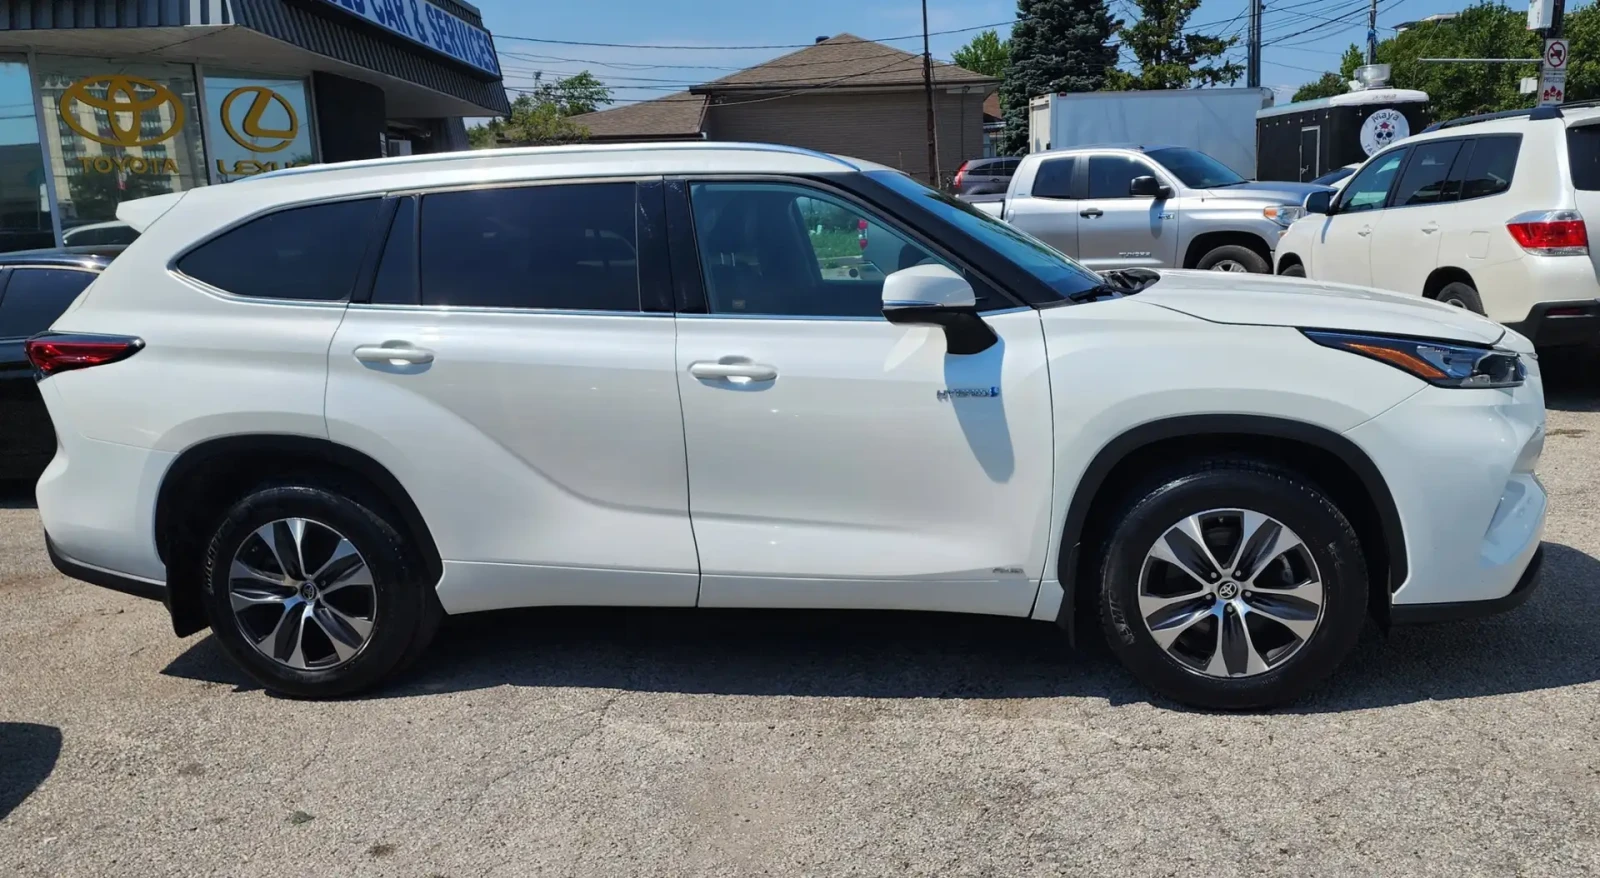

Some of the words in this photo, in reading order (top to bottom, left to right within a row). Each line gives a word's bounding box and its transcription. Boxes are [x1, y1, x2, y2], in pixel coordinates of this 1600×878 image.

[409, 0, 430, 44] &
[425, 3, 499, 74] SERVICES
[1371, 112, 1400, 122] Maya
[77, 156, 179, 174] TOYOTA
